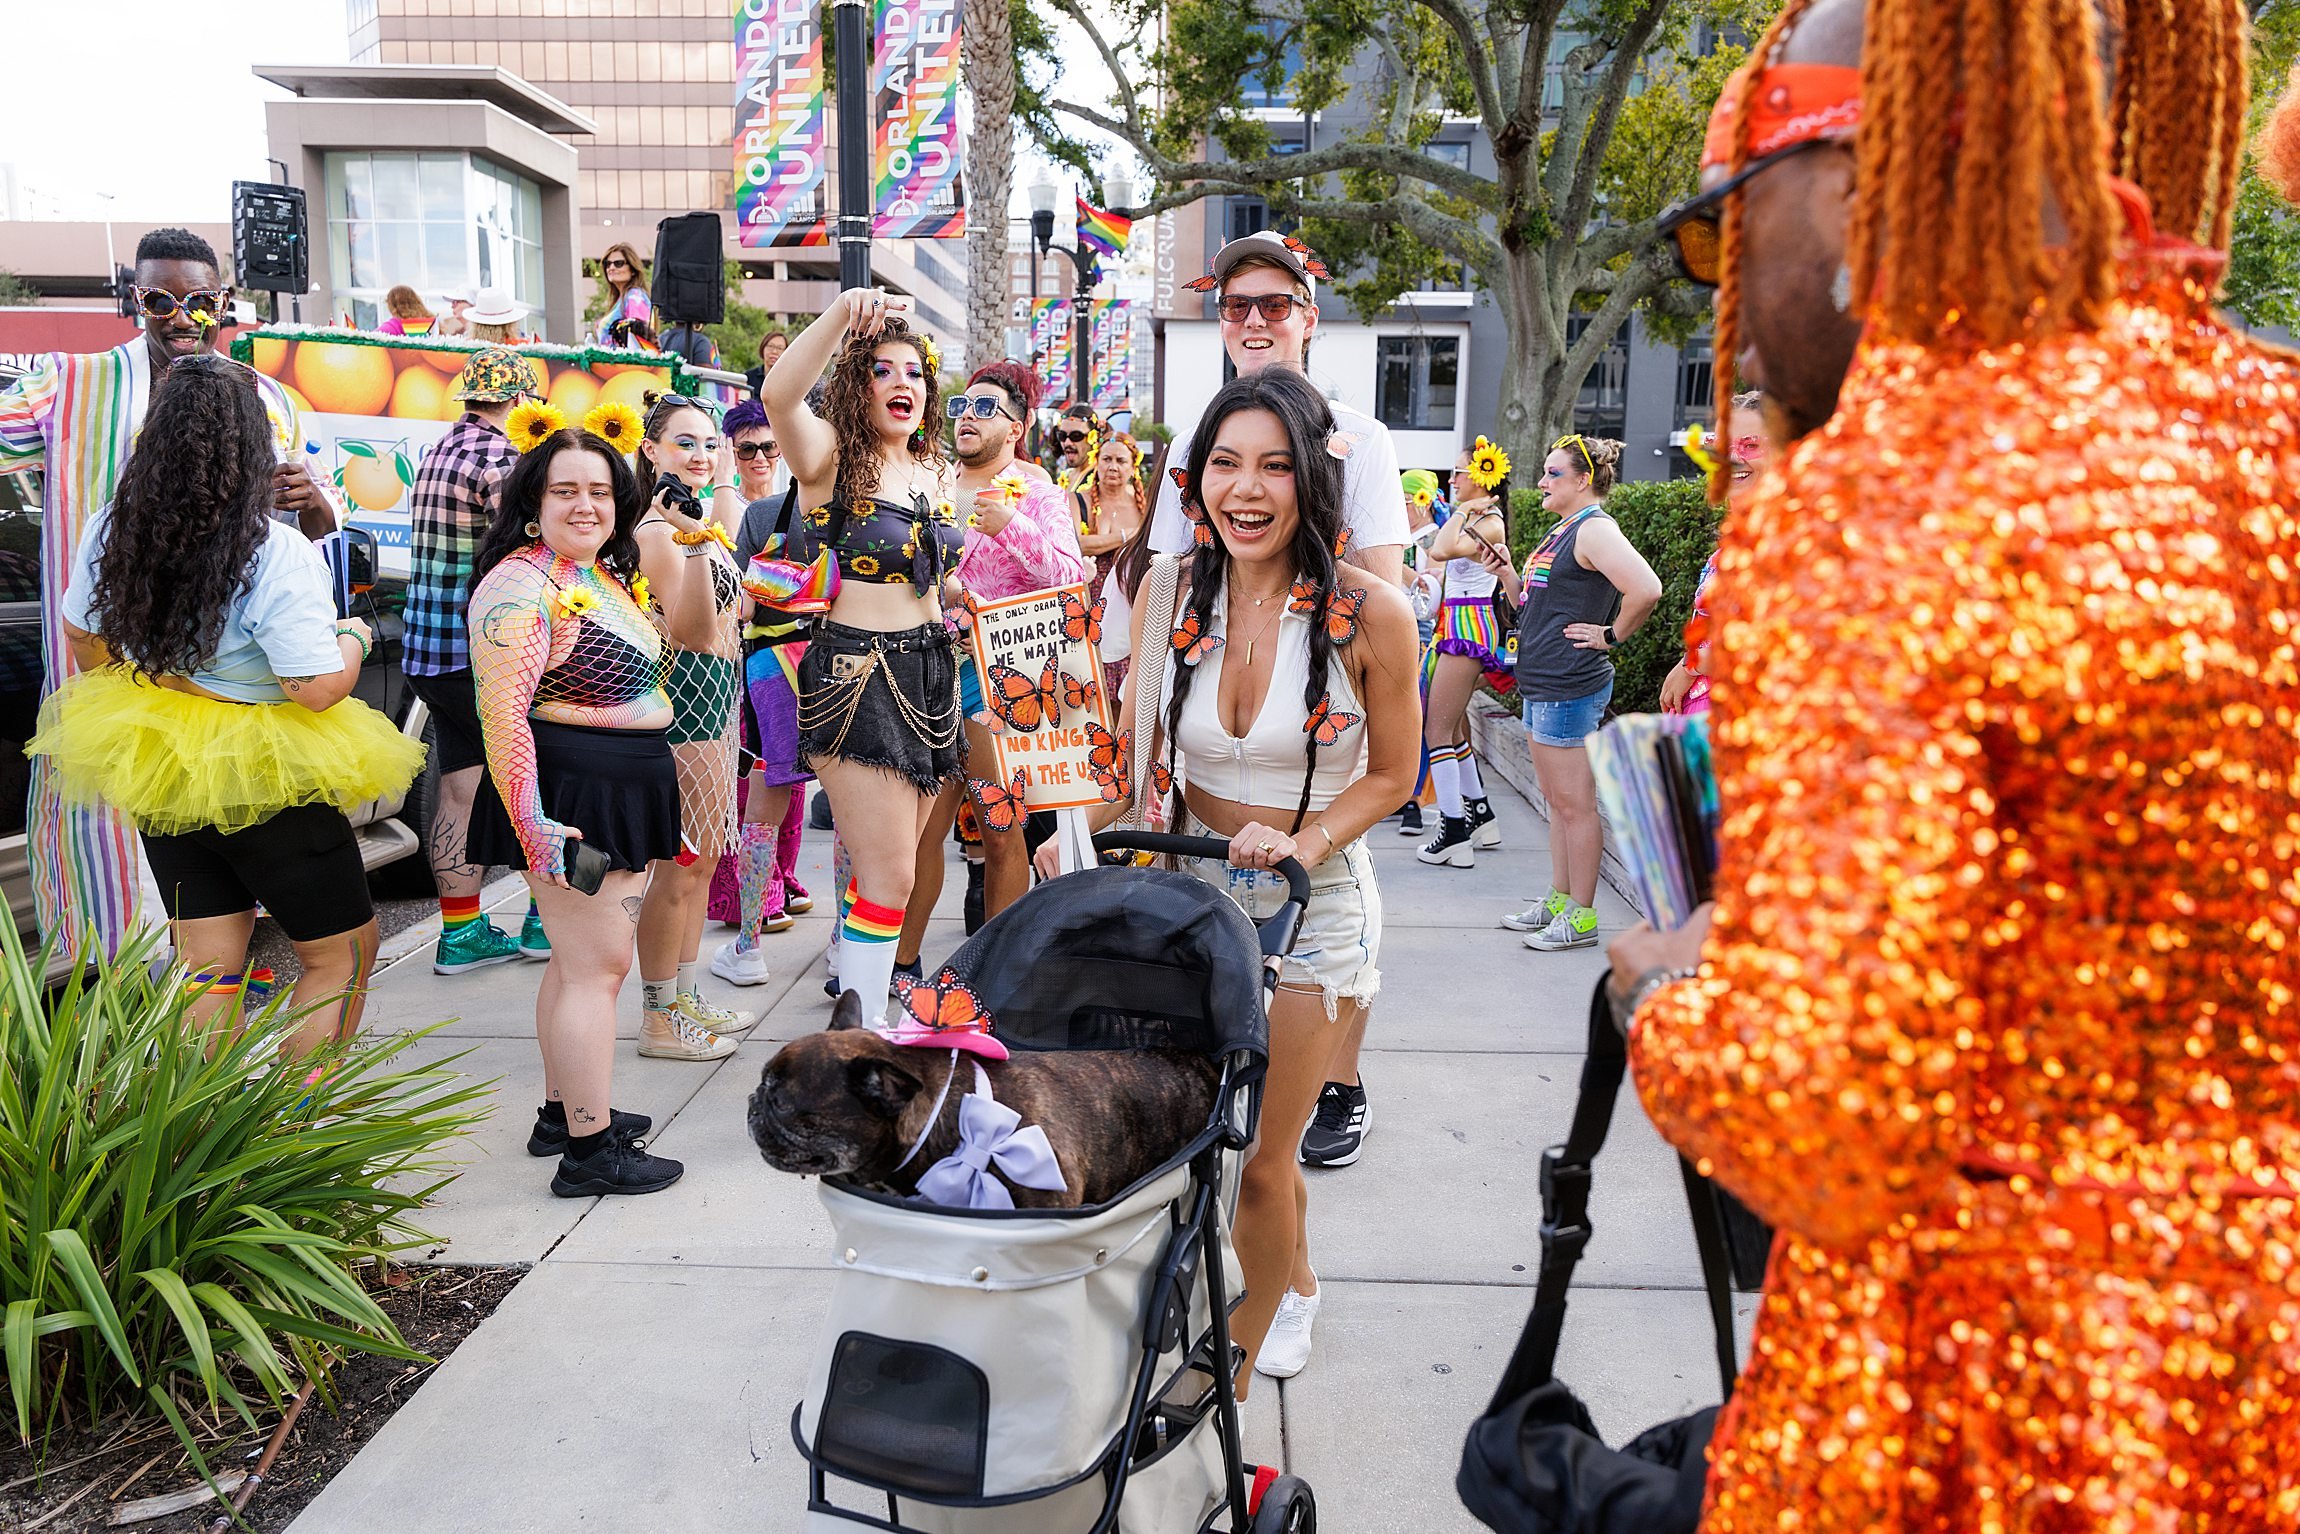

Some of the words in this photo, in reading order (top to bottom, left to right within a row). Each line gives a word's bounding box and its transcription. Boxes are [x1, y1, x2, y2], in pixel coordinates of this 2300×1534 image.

[744, 0, 771, 185] ORLANDO
[777, 0, 814, 185] UNITED
[885, 0, 912, 179] ORLAND
[1051, 308, 1067, 386] UNITED
[1097, 308, 1110, 385] ORLANDO
[1110, 308, 1127, 386] UNITED
[983, 612, 999, 624] THE
[1005, 606, 1028, 619] ONLY
[1034, 600, 1061, 612] ORAN
[995, 651, 1015, 666] WE
[1006, 736, 1031, 752] NO
[1035, 725, 1091, 752] KING
[1037, 761, 1071, 785] THE
